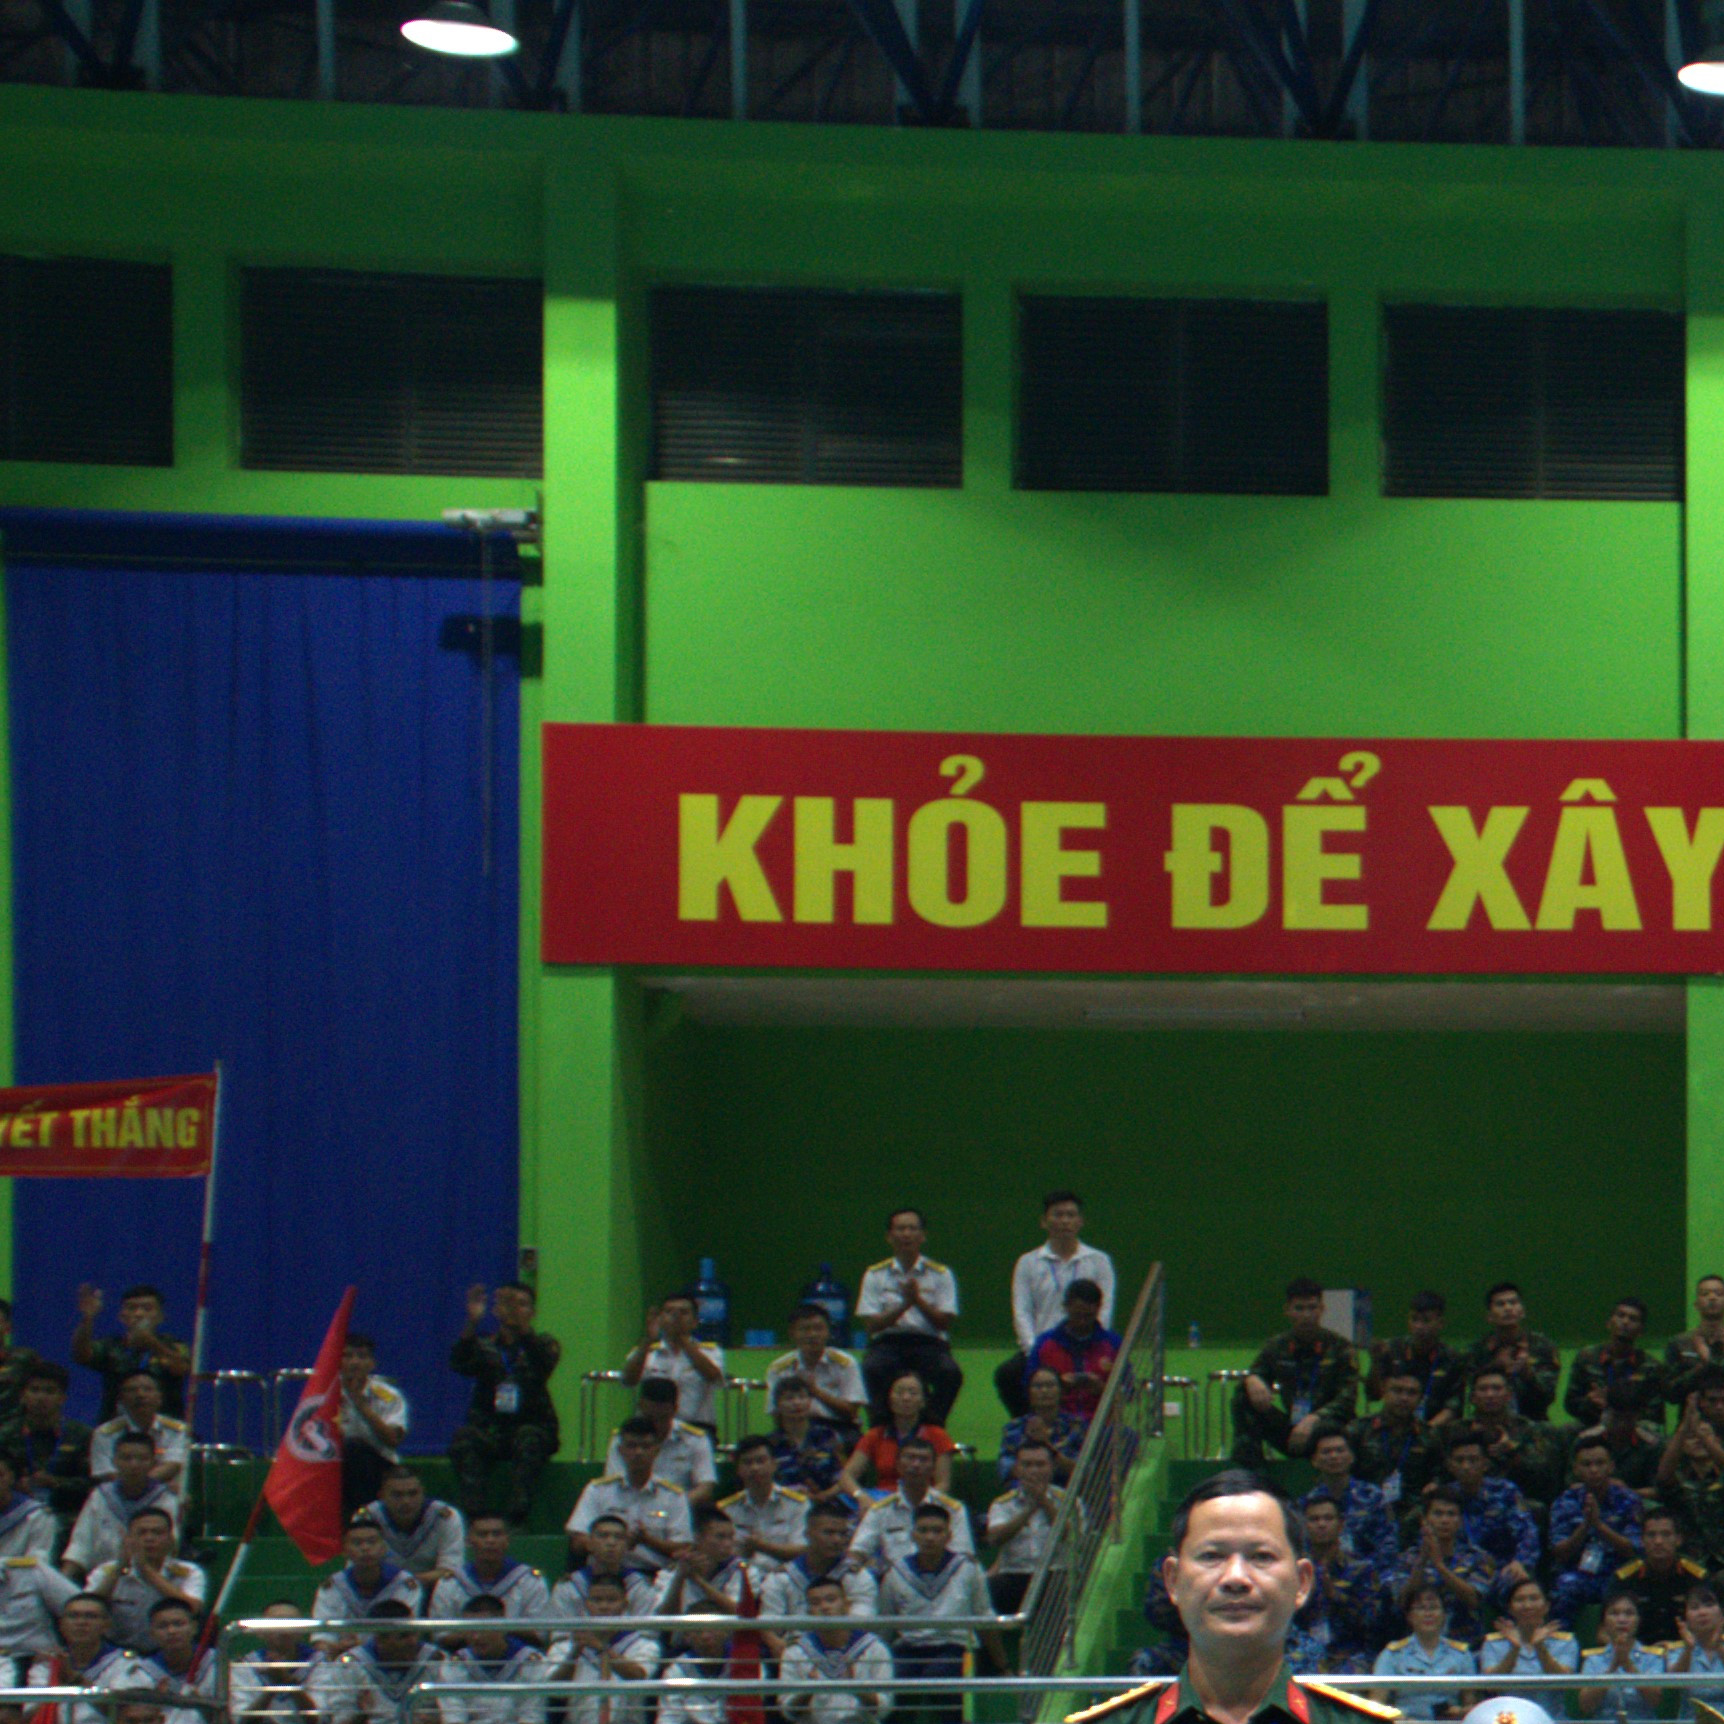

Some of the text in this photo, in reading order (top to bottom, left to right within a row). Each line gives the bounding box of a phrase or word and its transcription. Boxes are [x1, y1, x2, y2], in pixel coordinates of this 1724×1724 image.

[677, 753, 1108, 928] KHỎE
[1164, 751, 1383, 931] ĐỂ
[69, 1094, 200, 1149] THẮNG
